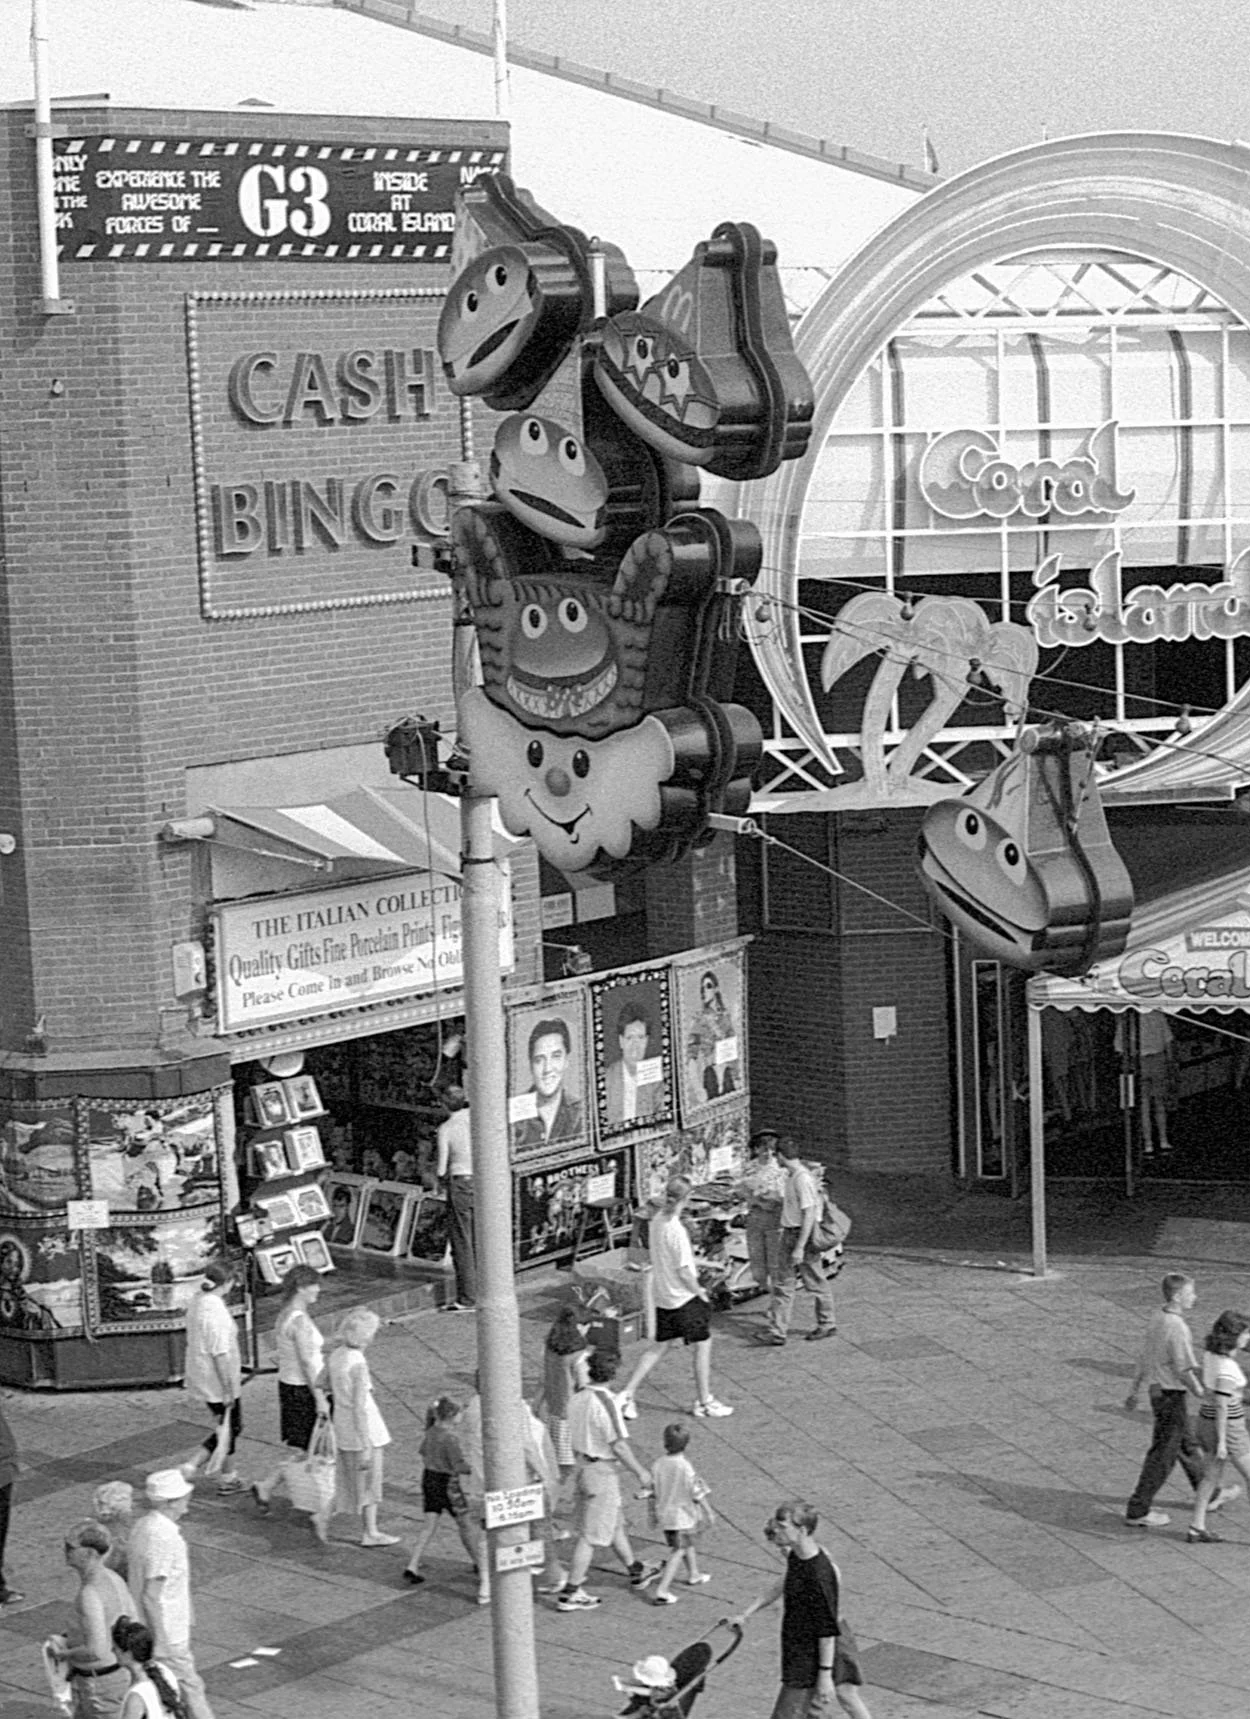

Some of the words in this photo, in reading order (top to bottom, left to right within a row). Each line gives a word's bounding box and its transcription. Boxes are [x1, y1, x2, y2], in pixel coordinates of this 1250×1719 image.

[95, 170, 186, 188] EXPERIENCE
[191, 171, 221, 188] THE
[373, 171, 428, 191] INSIDE
[121, 193, 202, 211] AWESOME
[238, 164, 331, 237] G3
[391, 194, 412, 211] AT
[105, 216, 164, 234] FORCES
[172, 215, 191, 232] OF
[348, 212, 397, 232] CORAL
[403, 212, 455, 232] ISLAND
[230, 348, 437, 428] CASH
[920, 420, 1136, 519] Coral
[212, 472, 450, 560] BINGO
[252, 915, 292, 939] THE
[296, 901, 369, 932] ITALIAN
[229, 950, 282, 987] Quality
[287, 941, 321, 970] Gifts
[323, 937, 347, 964] Fine
[351, 926, 398, 958] Porcelain
[243, 990, 284, 1008] Please
[288, 981, 324, 998] Come
[345, 968, 368, 988] and
[373, 963, 415, 982] Browse
